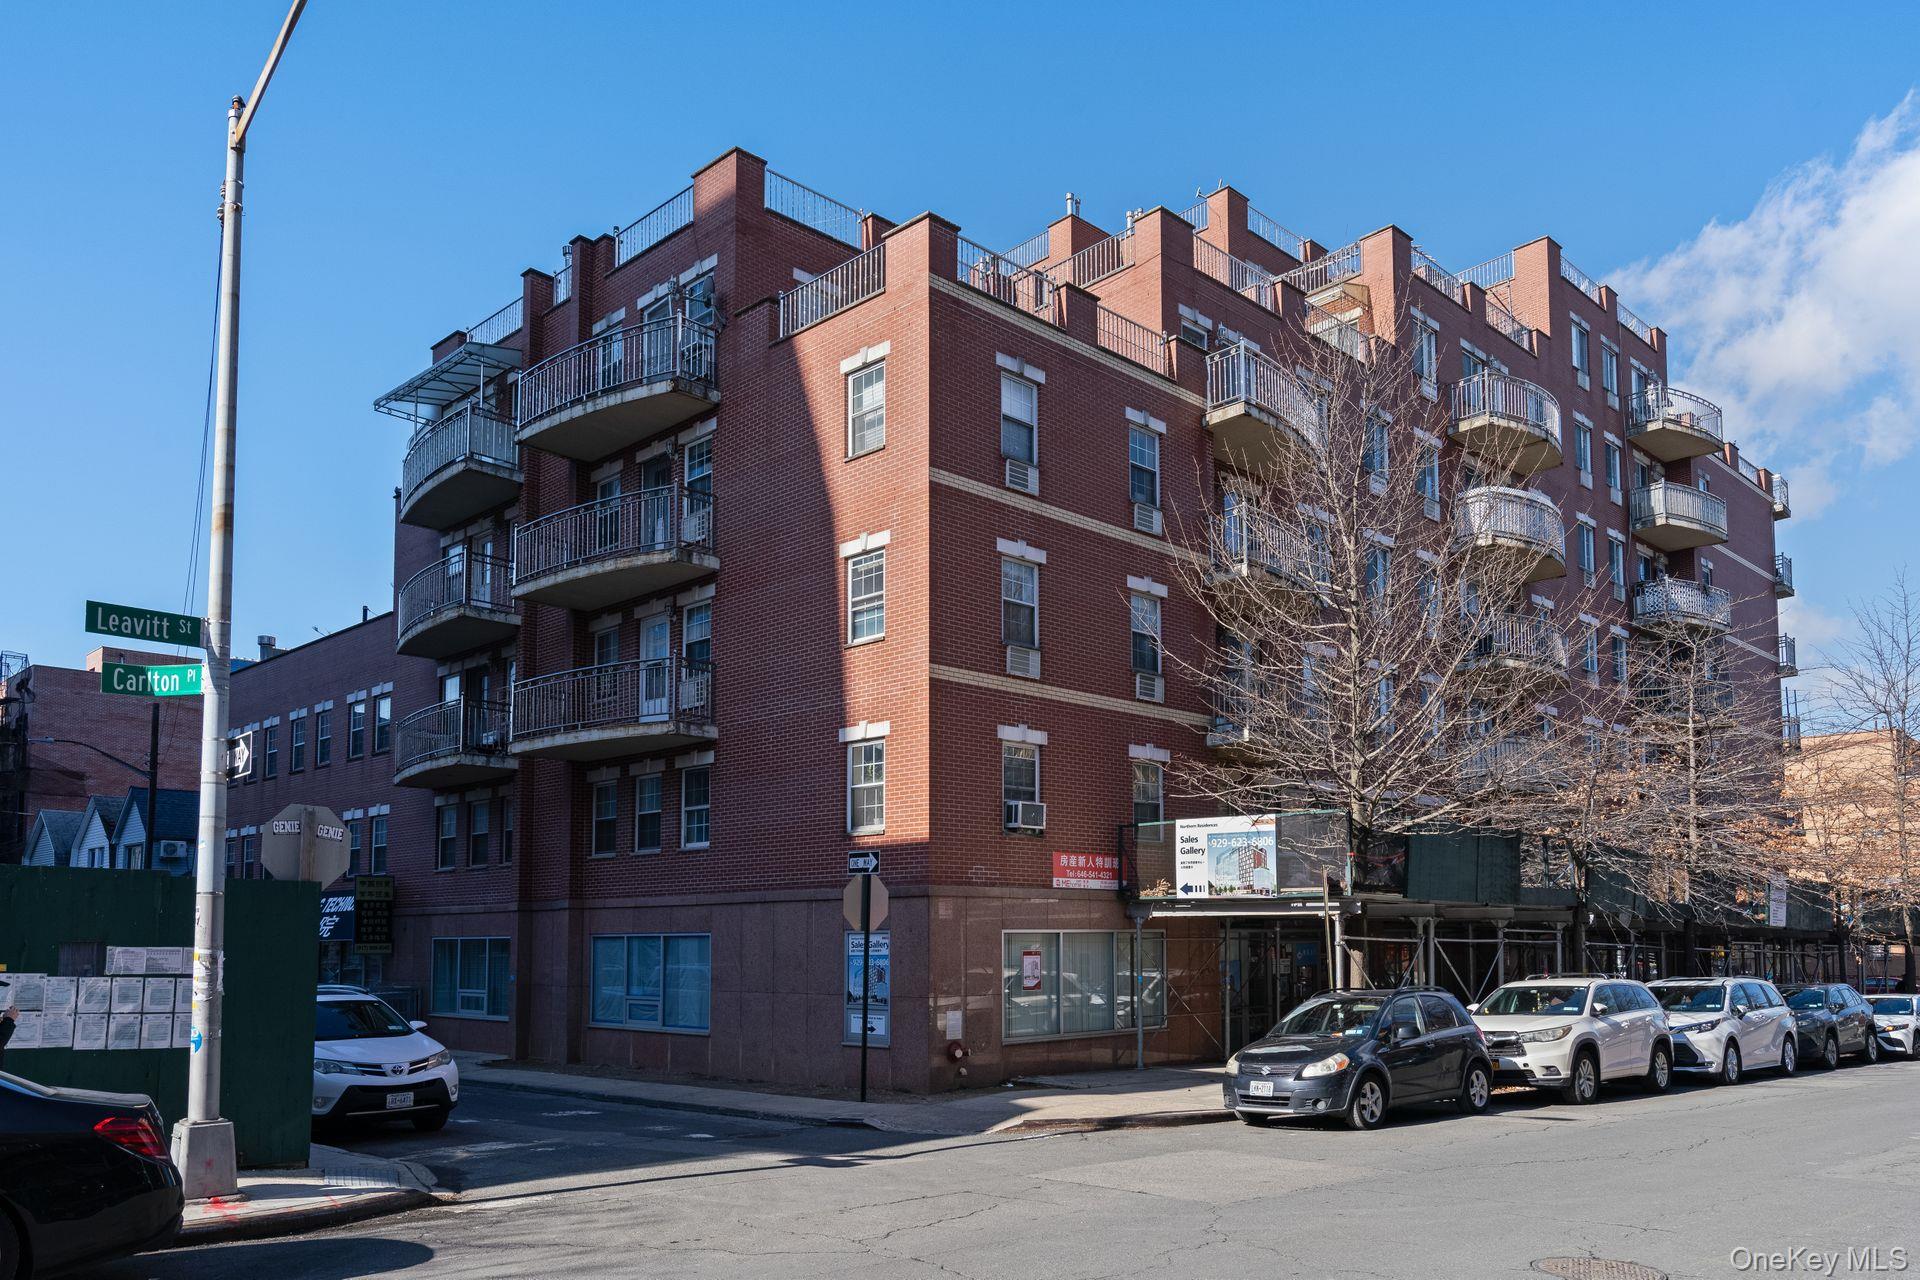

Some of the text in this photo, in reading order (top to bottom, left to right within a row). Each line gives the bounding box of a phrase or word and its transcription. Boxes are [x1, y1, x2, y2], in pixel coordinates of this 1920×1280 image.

[97, 606, 192, 639] Leavitt St
[113, 668, 196, 693] Carlton Pl
[273, 820, 300, 833] GENIE
[317, 824, 344, 840] GENIE
[1180, 835, 1199, 844] Sales
[1180, 847, 1206, 856] Gallery
[851, 858, 873, 867] ONE WAY
[851, 940, 889, 950] Sale Gallery
